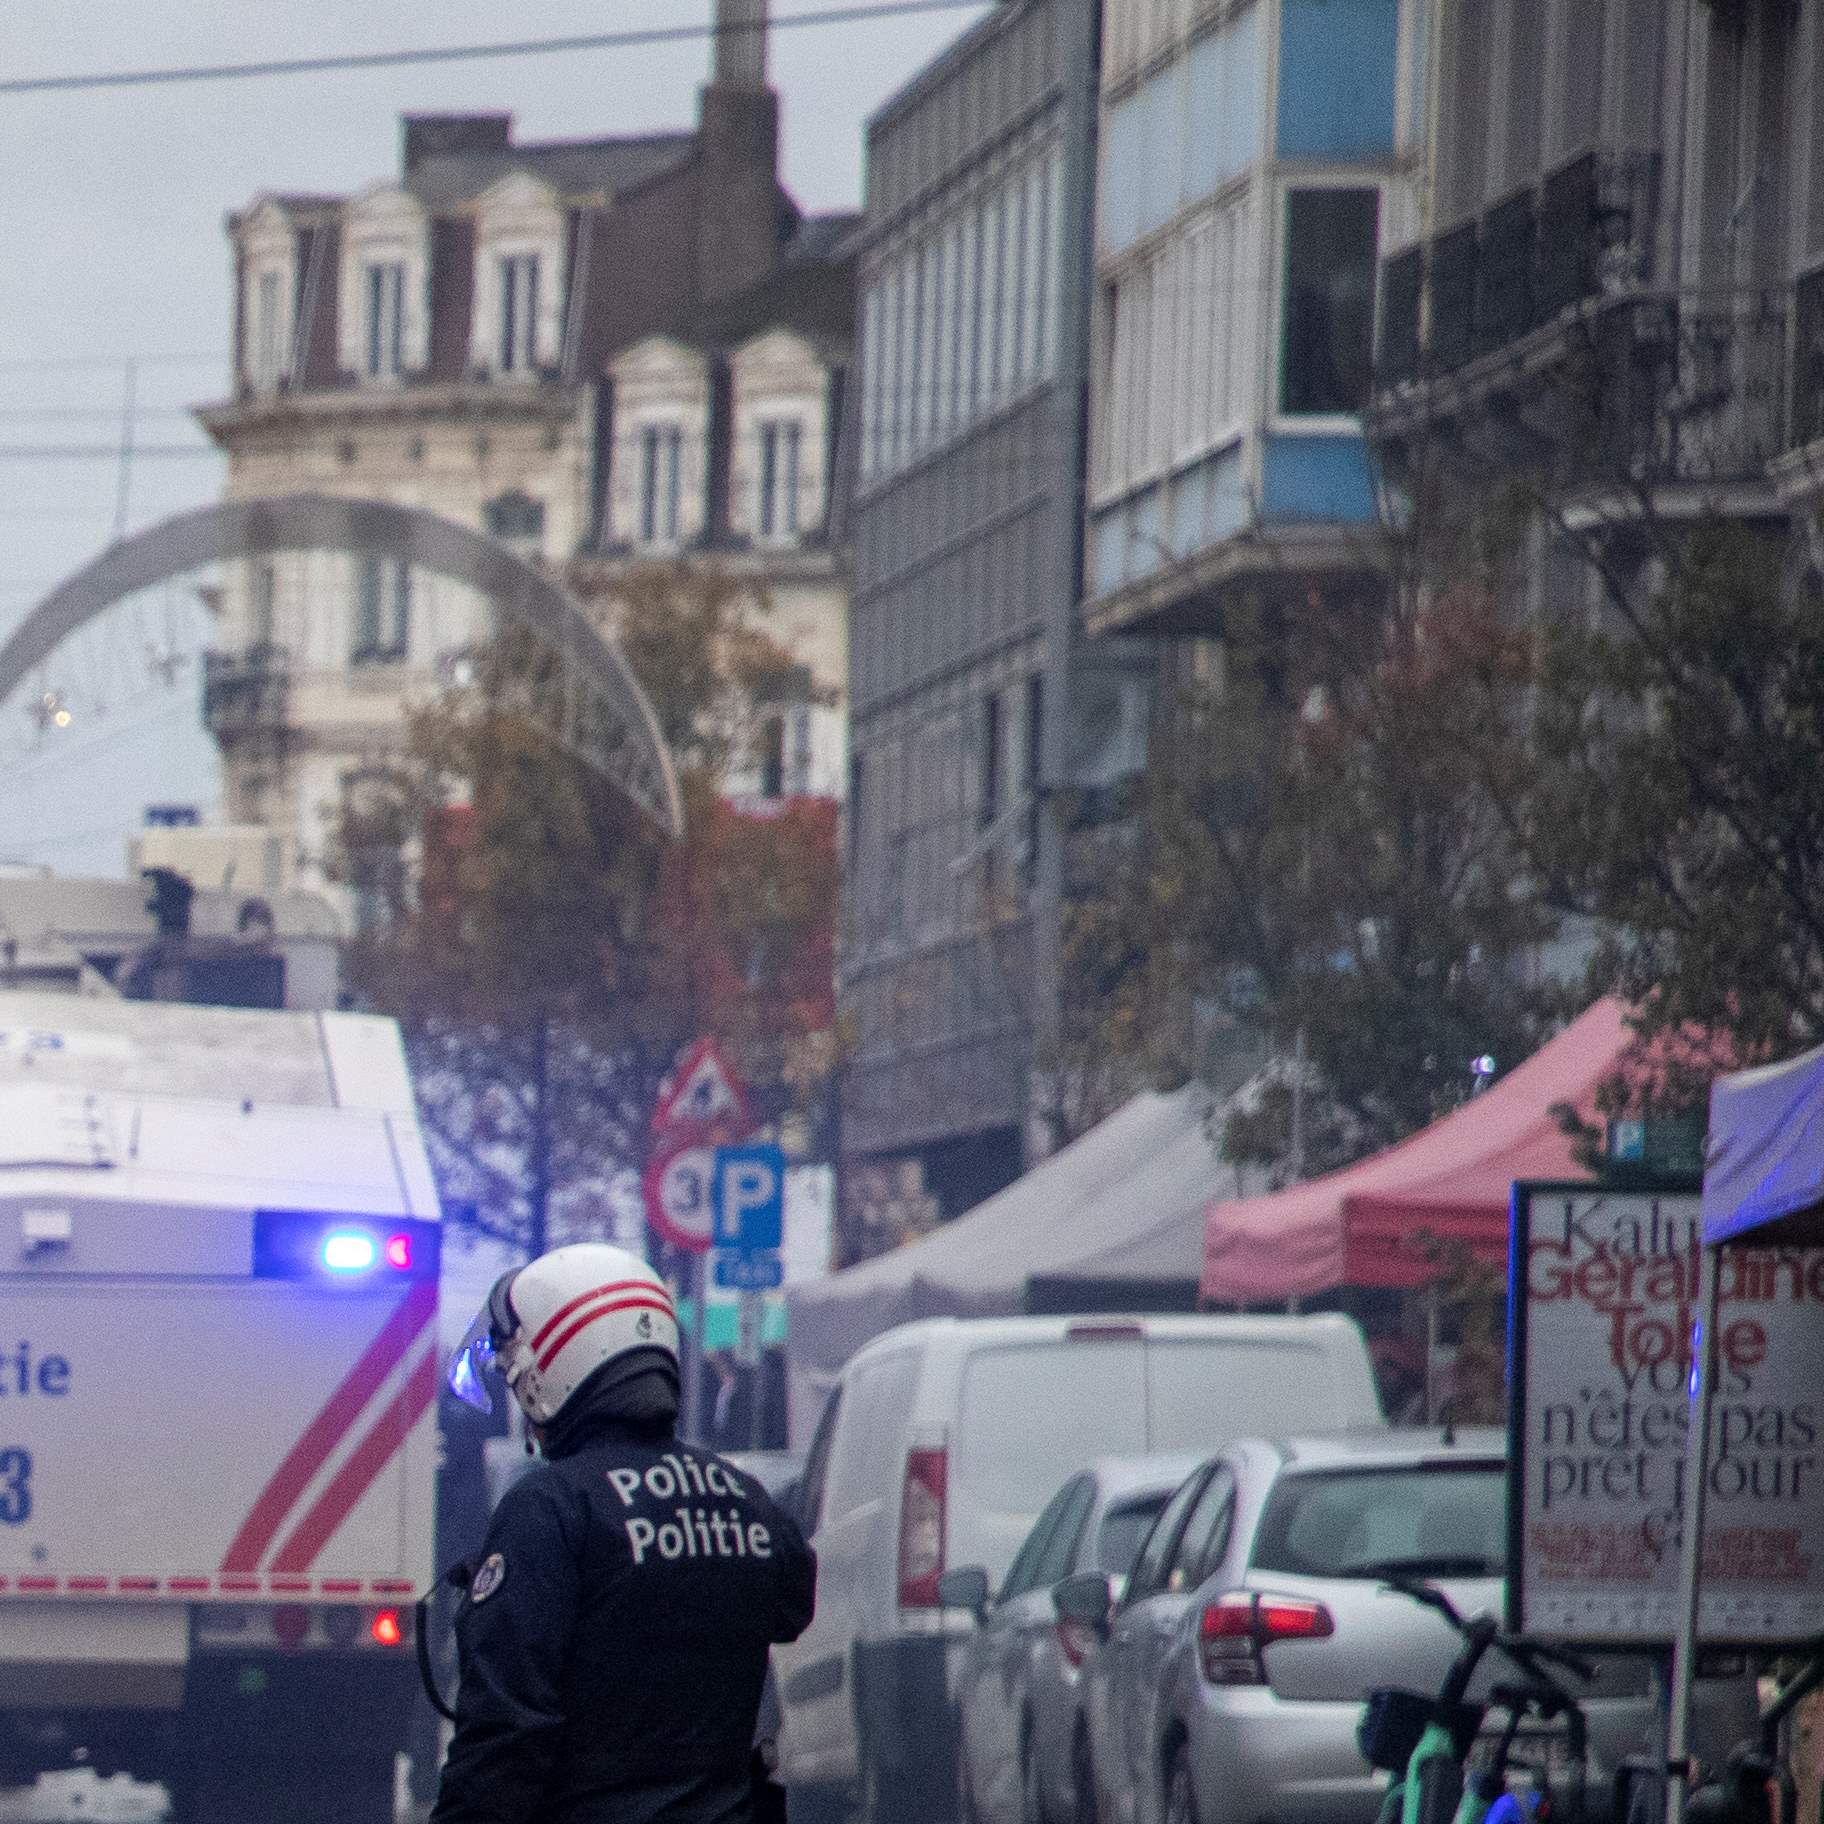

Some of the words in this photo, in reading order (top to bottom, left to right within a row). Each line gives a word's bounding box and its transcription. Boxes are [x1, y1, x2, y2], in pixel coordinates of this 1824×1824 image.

[673, 1168, 702, 1215] 3
[723, 1161, 775, 1235] P
[1564, 1199, 1700, 1254] Kalu
[1609, 1340, 1752, 1397] vos
[1716, 1403, 1816, 1460] pas
[624, 1508, 772, 1565] Politie
